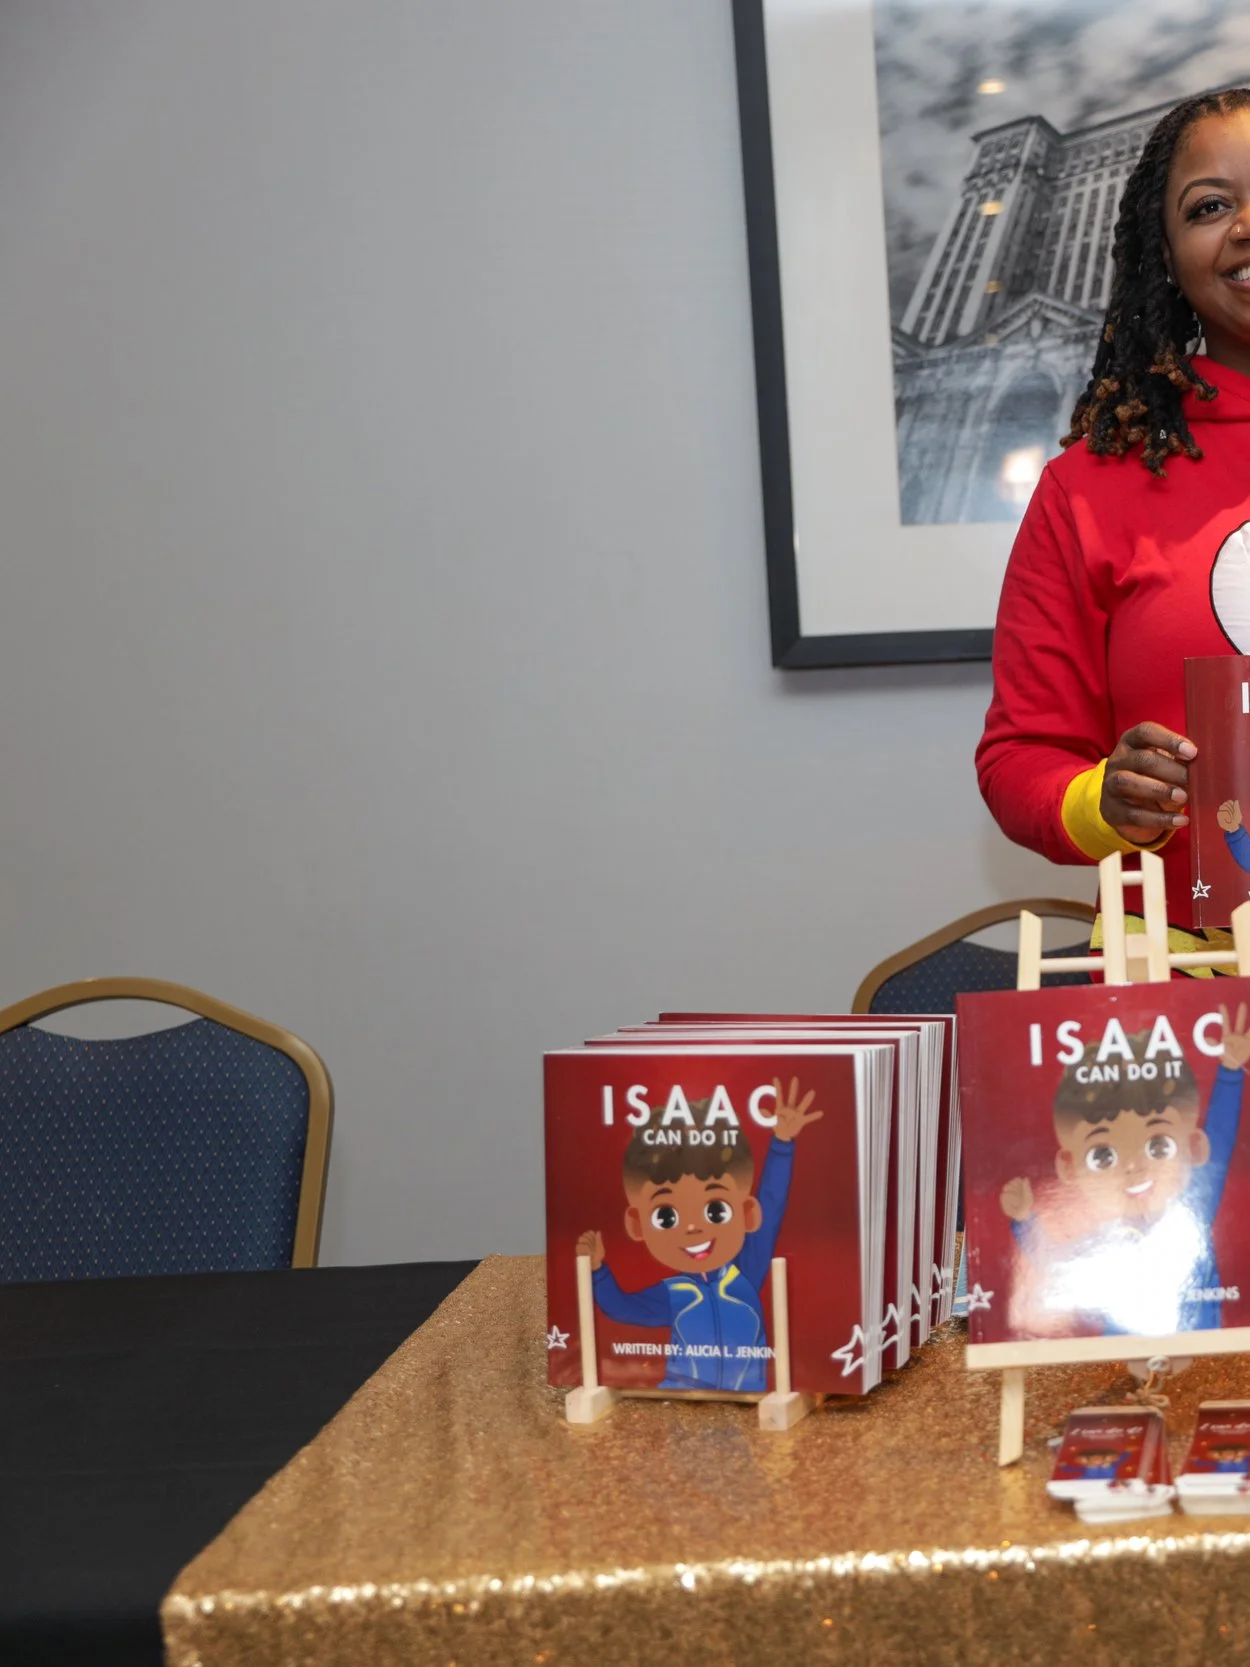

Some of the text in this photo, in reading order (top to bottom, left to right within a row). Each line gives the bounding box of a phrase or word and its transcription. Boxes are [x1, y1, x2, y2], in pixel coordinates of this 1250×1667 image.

[1029, 1011, 1225, 1067] ISAAC
[1075, 1061, 1183, 1084] CAN DO IT
[602, 1084, 778, 1127] ISAAC
[643, 1129, 739, 1146] CAN DO IT
[612, 1342, 777, 1359] WRITTEN BY: ALICIA L. JENKIN
